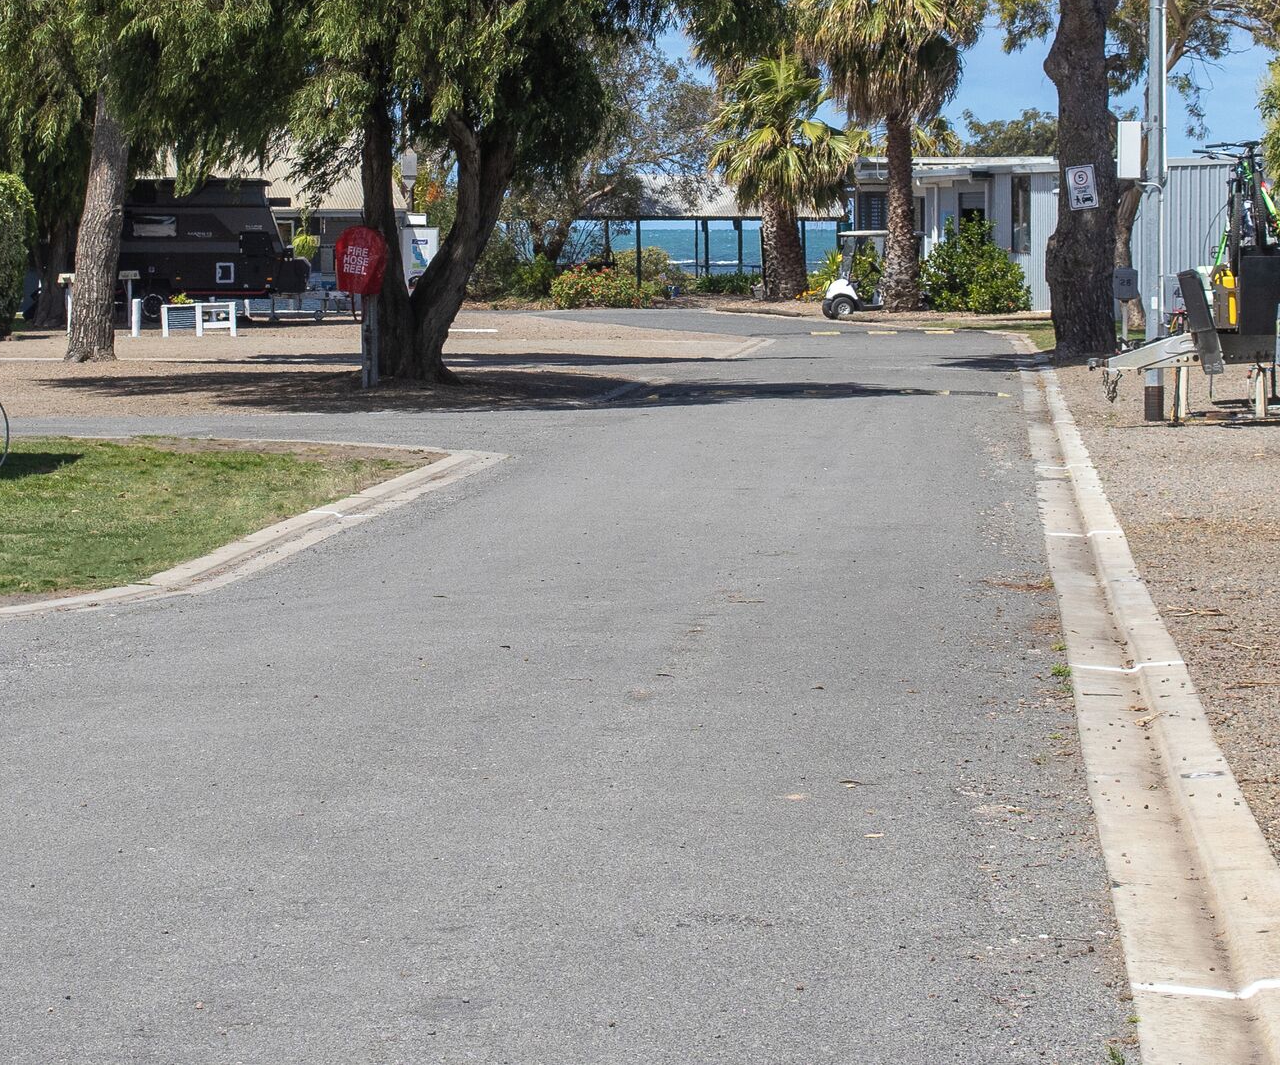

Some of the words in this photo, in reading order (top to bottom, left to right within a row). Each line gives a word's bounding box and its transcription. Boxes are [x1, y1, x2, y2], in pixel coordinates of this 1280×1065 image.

[1078, 173, 1084, 183] 5
[347, 245, 369, 257] FIRE
[343, 254, 370, 267] HOSE
[343, 263, 367, 276] REEL
